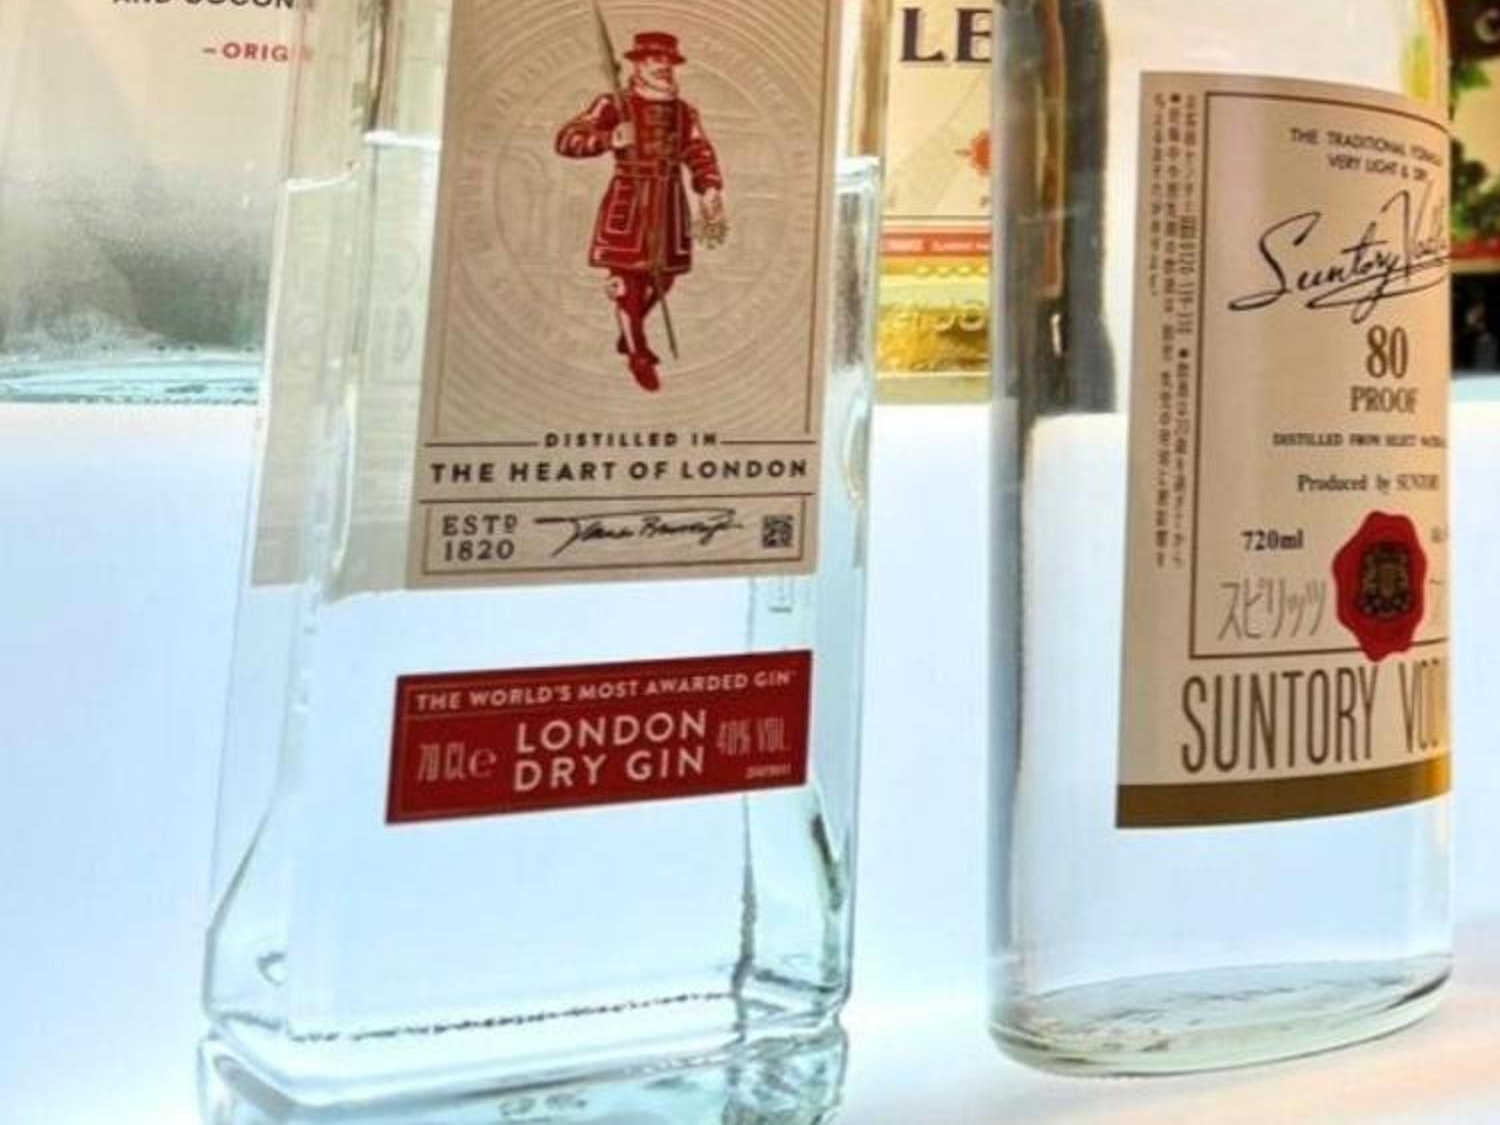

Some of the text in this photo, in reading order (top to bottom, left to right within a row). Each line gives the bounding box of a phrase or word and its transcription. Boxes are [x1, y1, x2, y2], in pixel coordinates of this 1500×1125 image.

[222, 41, 290, 63] ORIG
[1288, 126, 1321, 145] THE
[1365, 324, 1409, 379] 80
[1350, 384, 1419, 415] PROOF
[543, 431, 719, 449] DISTILLED IN
[429, 458, 809, 485] THE HEART OF LONDON
[1297, 473, 1368, 493] Produced
[442, 538, 517, 563] 1820
[1240, 529, 1304, 552] 720ml
[1216, 576, 1327, 642] スピリッツ
[415, 669, 791, 713] THE WORLD'S MOST AWARDED GIN
[515, 708, 707, 755] LONDON
[1181, 664, 1380, 774] SUNTORY
[513, 752, 607, 793] DRY
[625, 745, 705, 783] GIN
